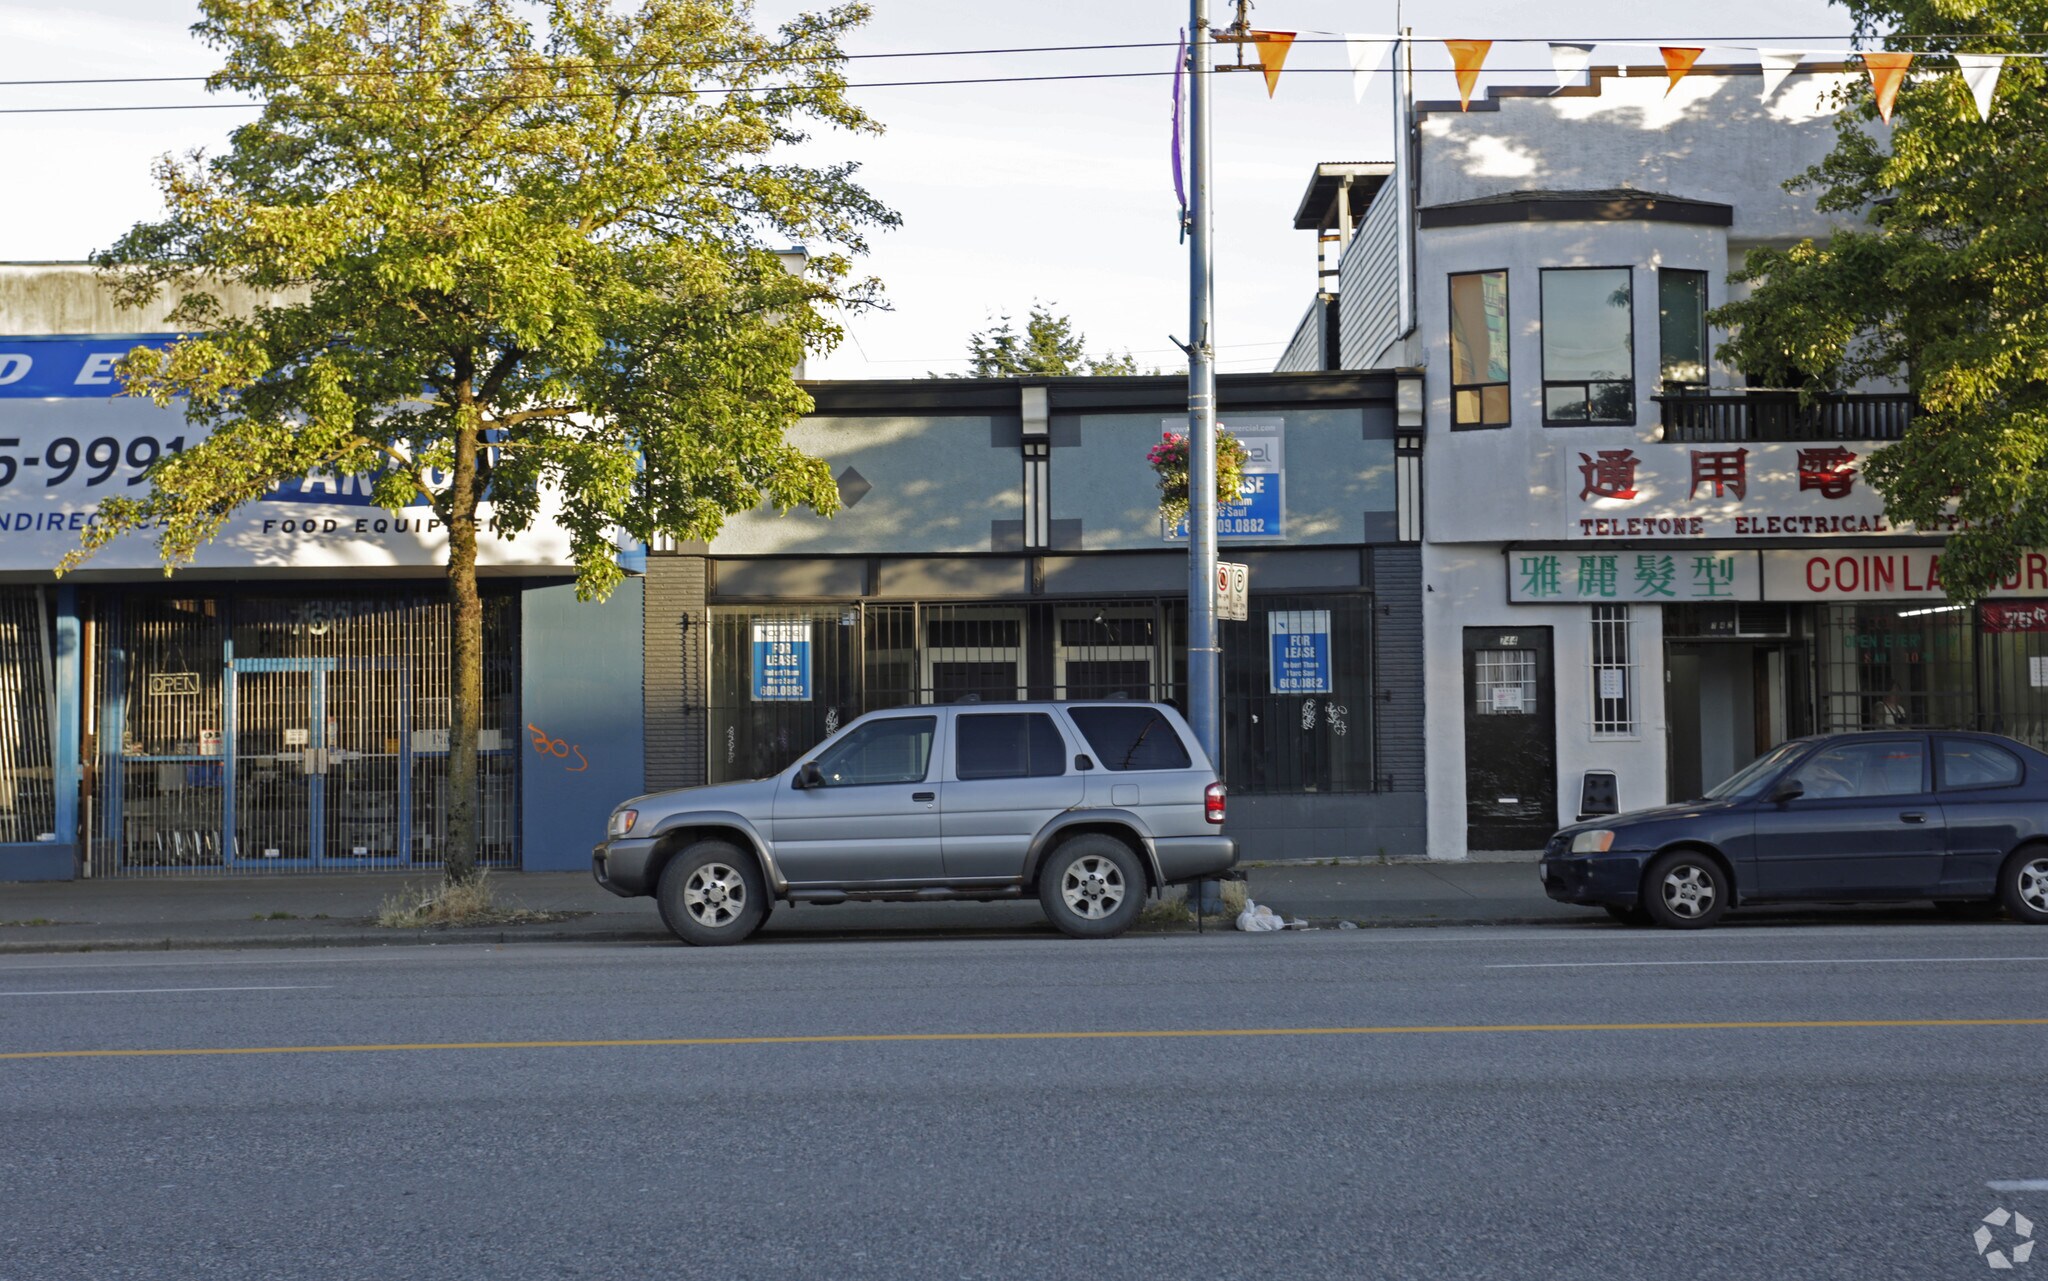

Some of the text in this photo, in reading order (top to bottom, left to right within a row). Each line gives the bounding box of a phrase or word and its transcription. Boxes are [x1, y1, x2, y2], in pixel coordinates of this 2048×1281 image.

[1227, 507, 1247, 517] Saul
[262, 519, 337, 534] FOOD
[1580, 514, 1888, 536] TELETONE ELECTRICAL
[1520, 554, 1734, 598] 雅麗髮型
[1290, 635, 1311, 647] FOR
[772, 643, 792, 655] FOR
[1285, 647, 1315, 659] LEASE
[766, 655, 798, 666] LEASE
[153, 676, 196, 692] OPEN
